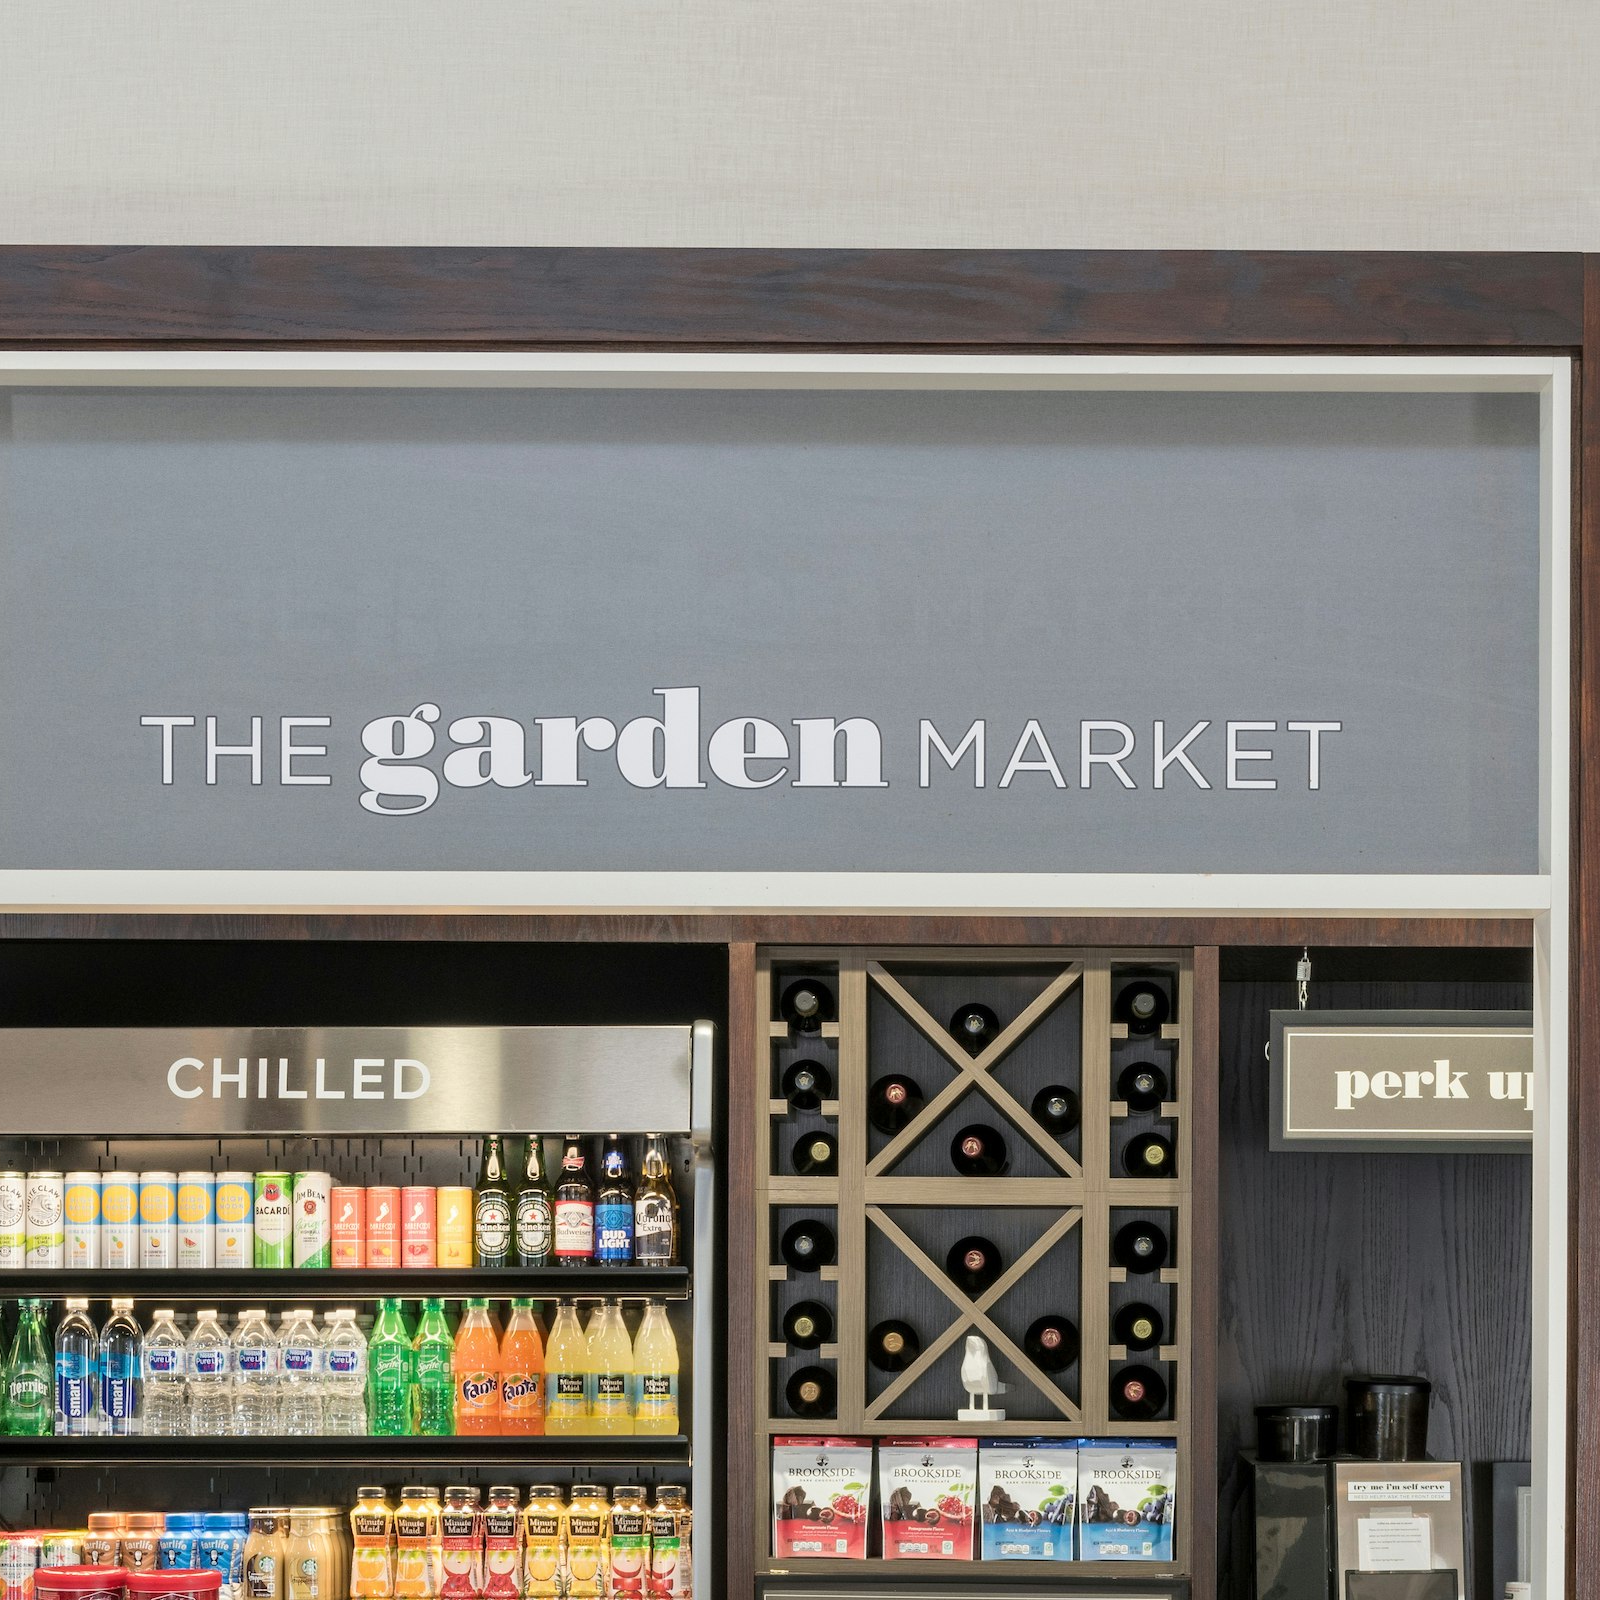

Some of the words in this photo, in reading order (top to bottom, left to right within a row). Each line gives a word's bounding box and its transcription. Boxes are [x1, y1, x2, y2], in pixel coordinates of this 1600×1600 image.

[140, 716, 333, 787] THE
[358, 686, 889, 817] garden
[917, 719, 1343, 791] MARKET
[166, 1058, 431, 1101] CHILLED
[1334, 1060, 1469, 1111] perk
[1488, 1070, 1534, 1111] u
[636, 1211, 671, 1225] Corona
[476, 1223, 511, 1232] Heineken
[556, 1228, 592, 1236] Budweiser
[642, 1224, 662, 1232] Extra
[602, 1230, 627, 1240] BUD
[599, 1239, 631, 1249] LIGHT
[463, 1379, 498, 1401] Fanta
[502, 1378, 536, 1400] Fanta
[69, 1378, 81, 1417] smart
[788, 1467, 856, 1478] BROOKSIDE
[894, 1468, 962, 1479] BROOKSIDE
[1093, 1469, 1161, 1479] BROOKSIDE
[1353, 1484, 1367, 1492] try
[529, 1518, 558, 1527] Minute
[535, 1526, 554, 1534] Maid
